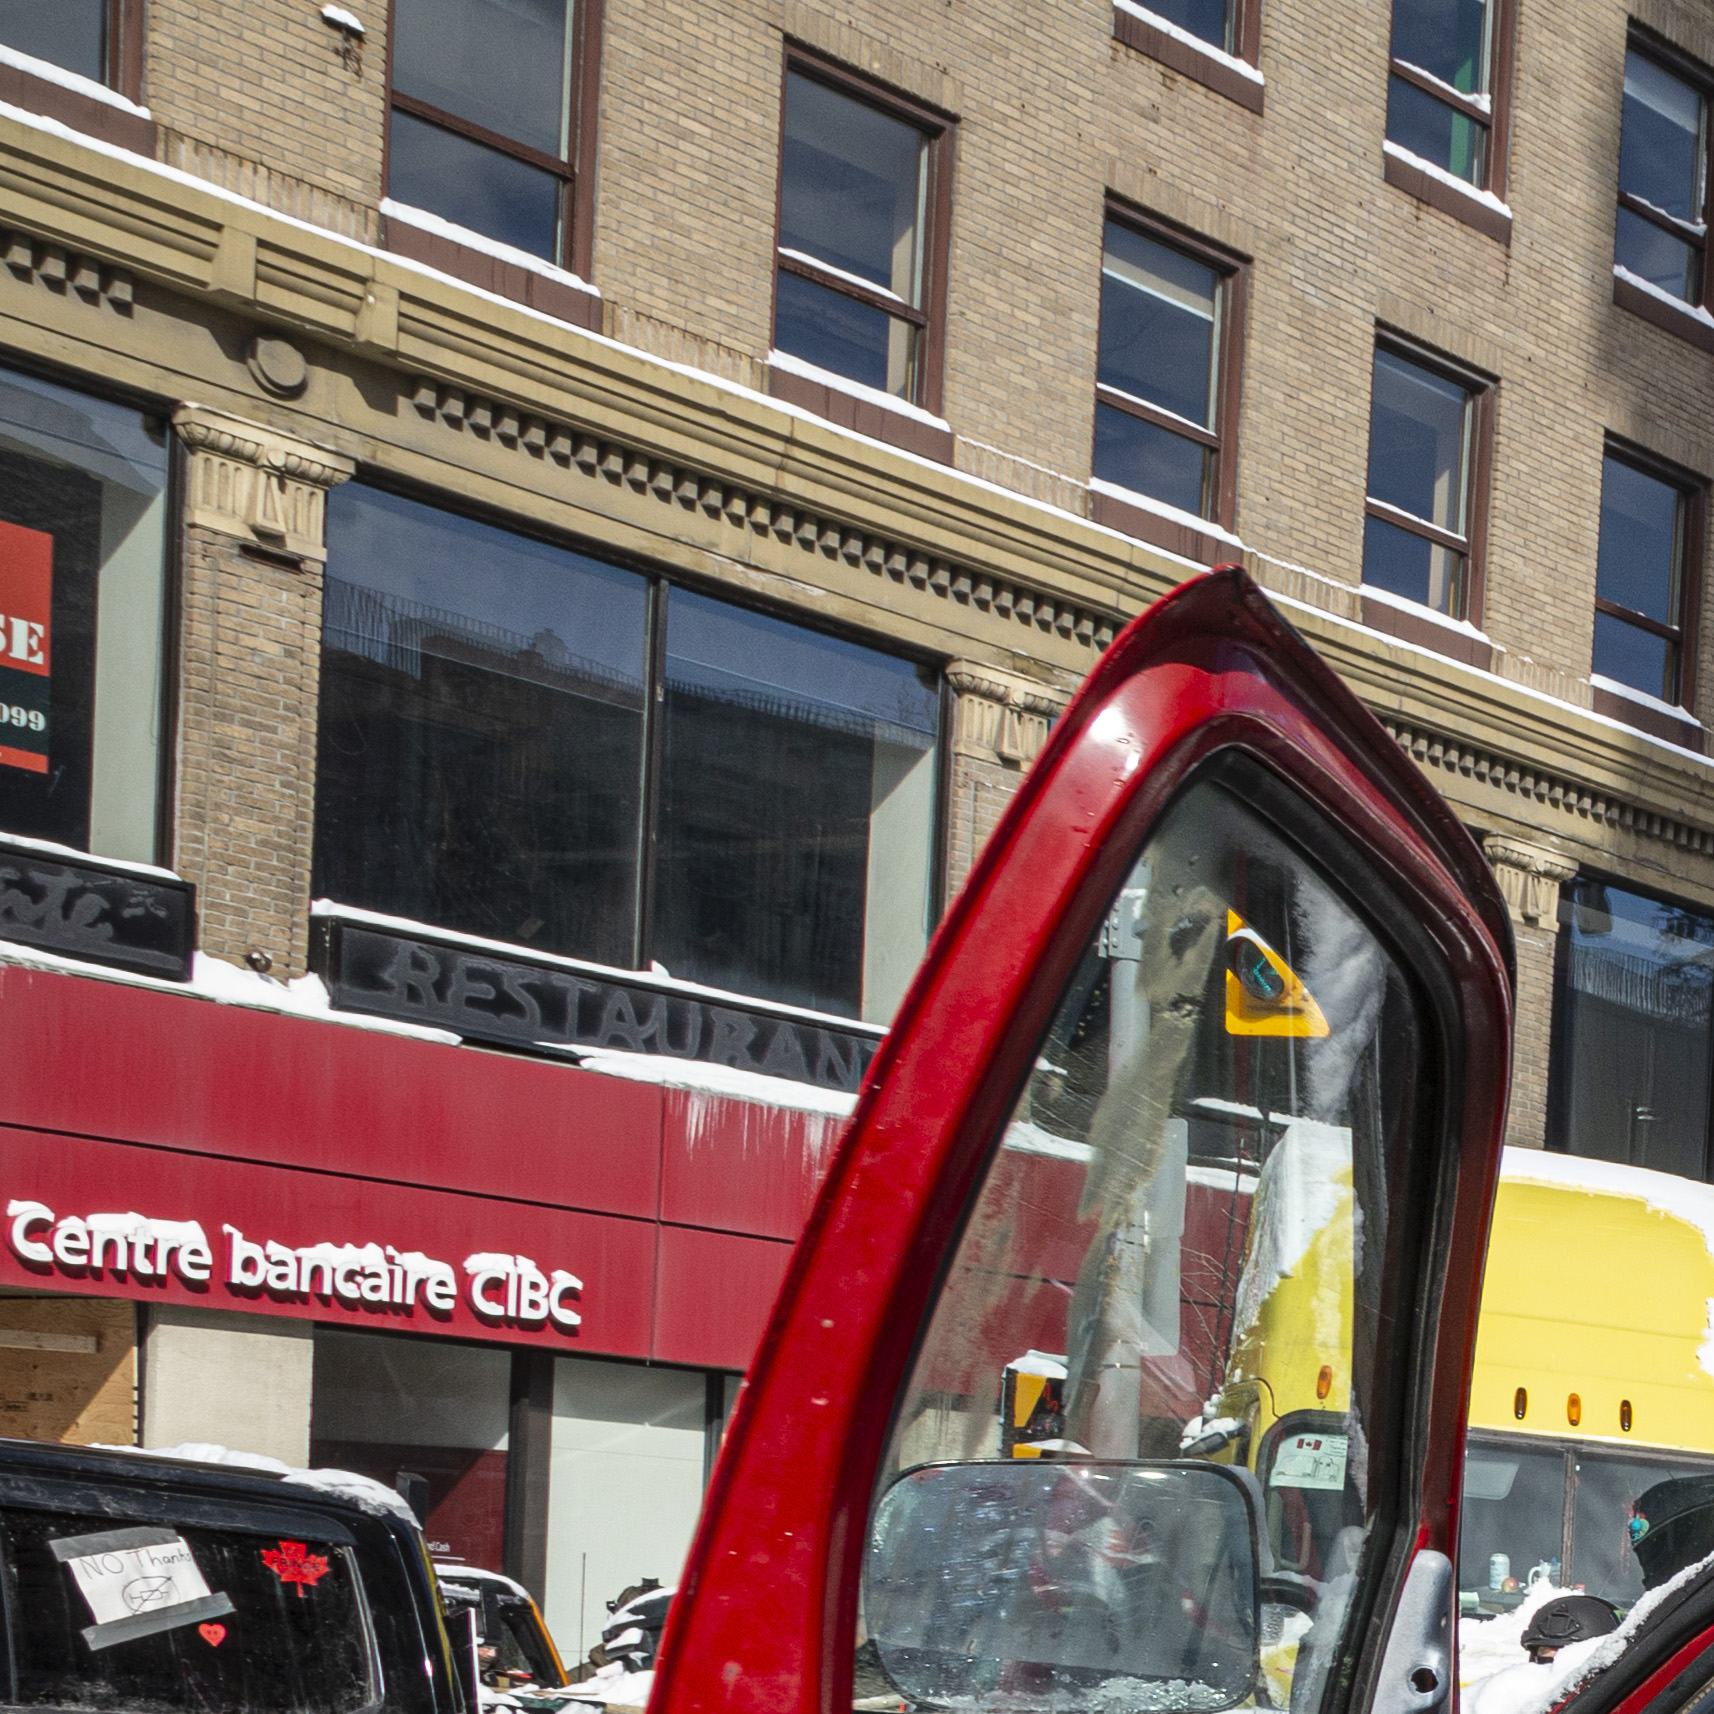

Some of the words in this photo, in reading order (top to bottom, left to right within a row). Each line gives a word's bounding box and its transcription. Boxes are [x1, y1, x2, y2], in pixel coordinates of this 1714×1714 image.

[8, 1204, 213, 1282] Centre
[224, 1227, 457, 1311] bancaire
[472, 1260, 583, 1326] CIBC
[79, 1552, 124, 1580] NO
